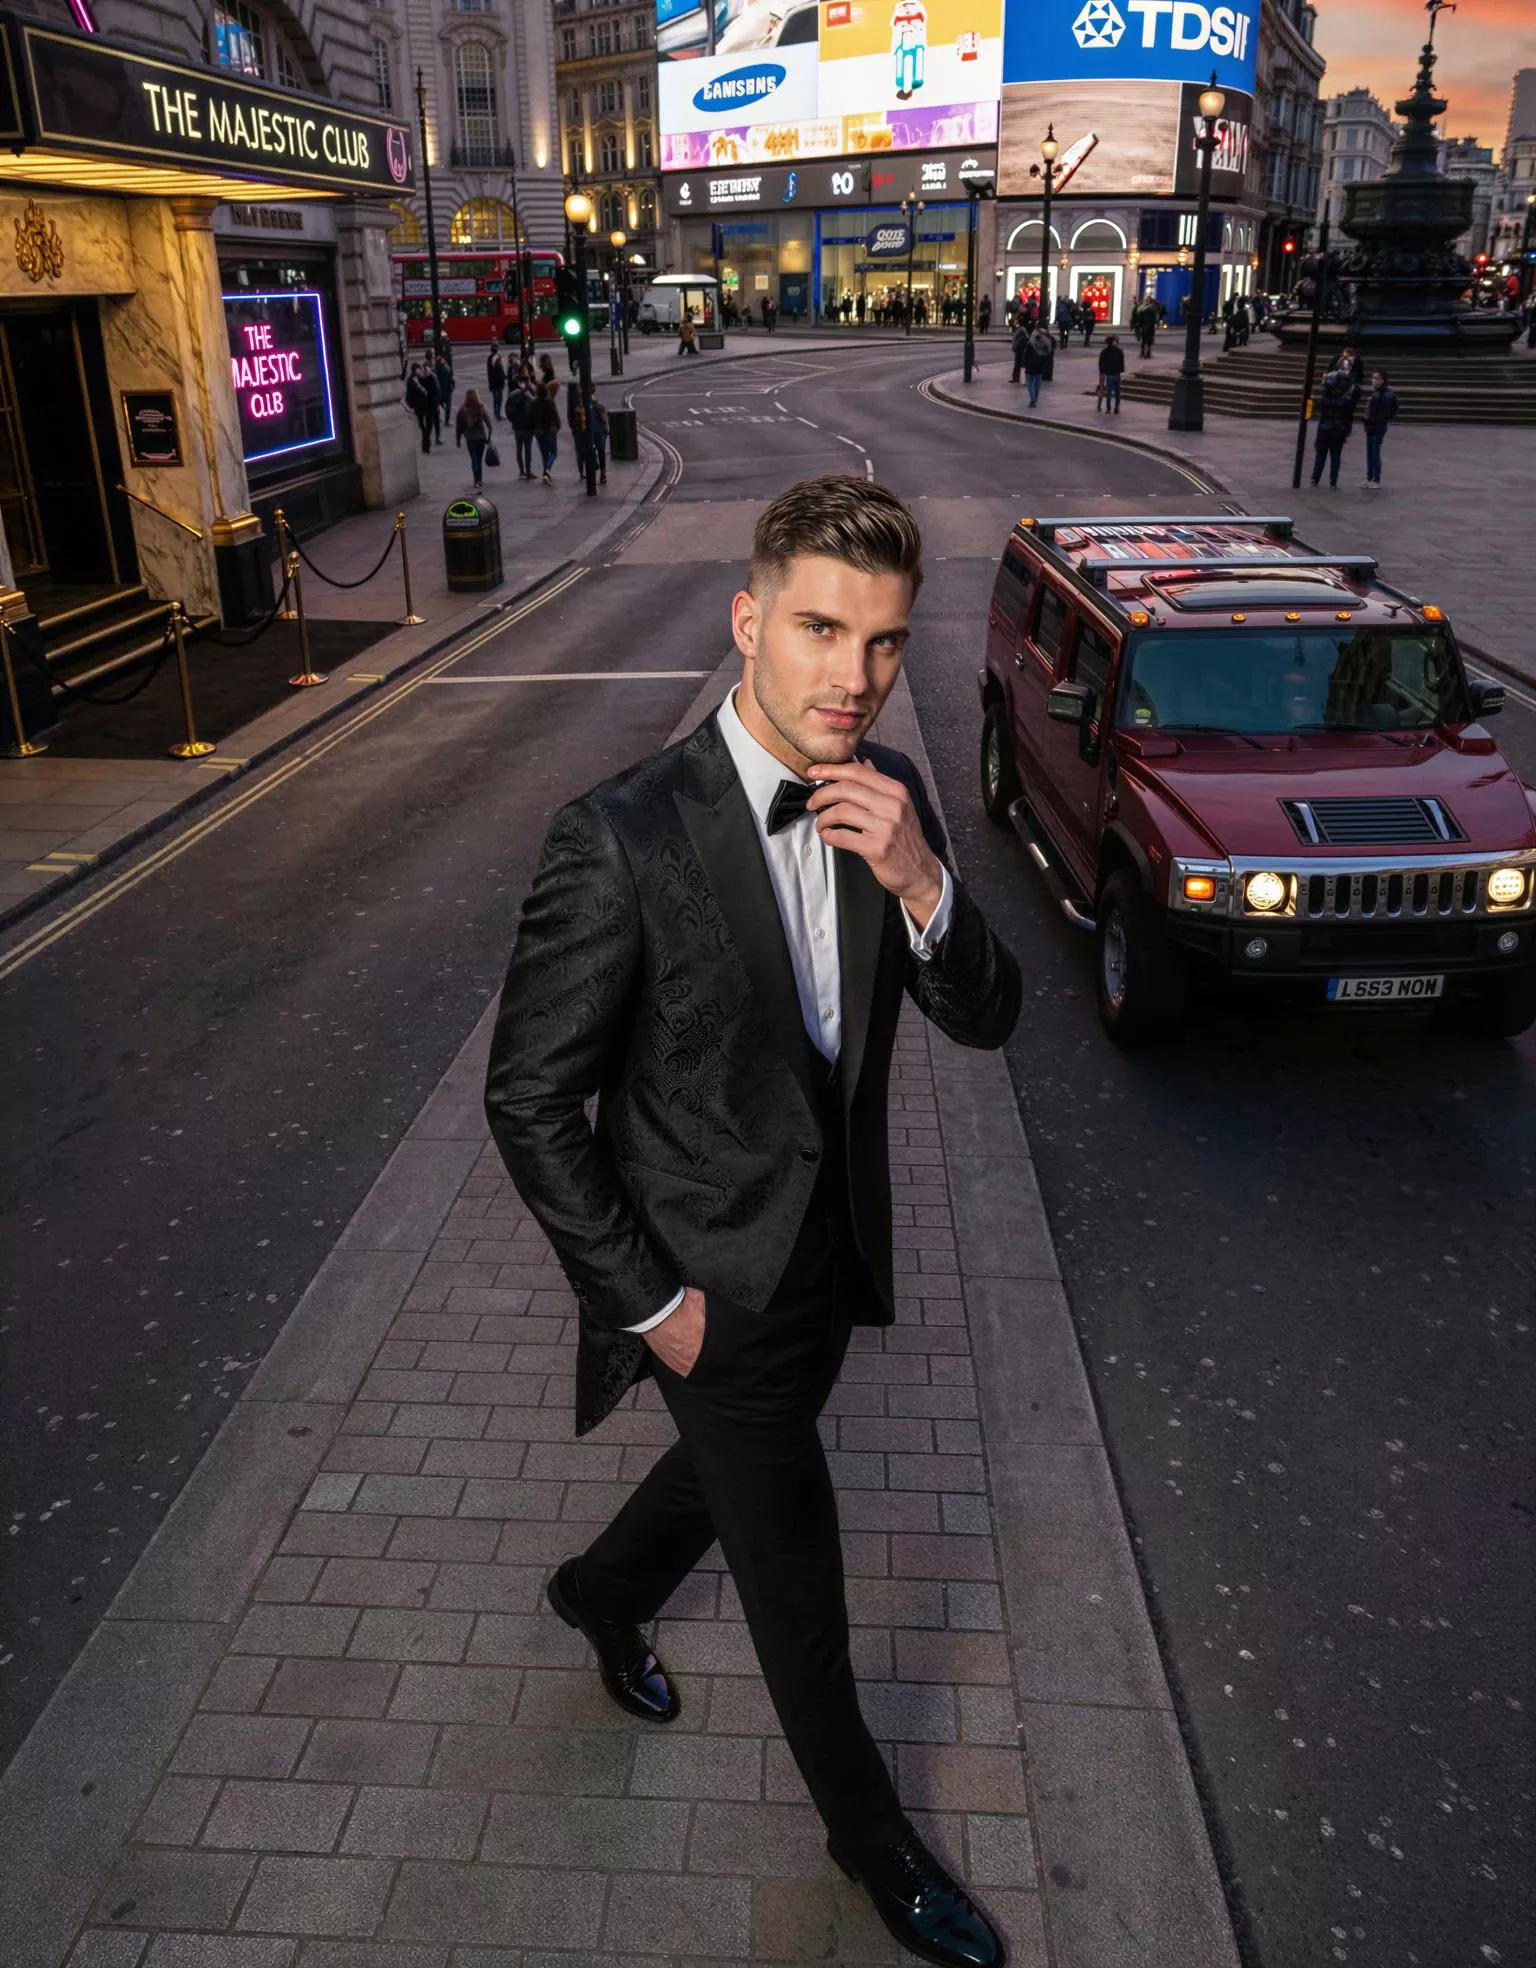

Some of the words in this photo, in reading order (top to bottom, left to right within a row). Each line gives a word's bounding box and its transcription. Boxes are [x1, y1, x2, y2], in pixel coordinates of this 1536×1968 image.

[142, 81, 202, 139] THE
[208, 97, 319, 160] MAJESTIC
[322, 124, 371, 169] CLUB
[243, 325, 274, 351] THE
